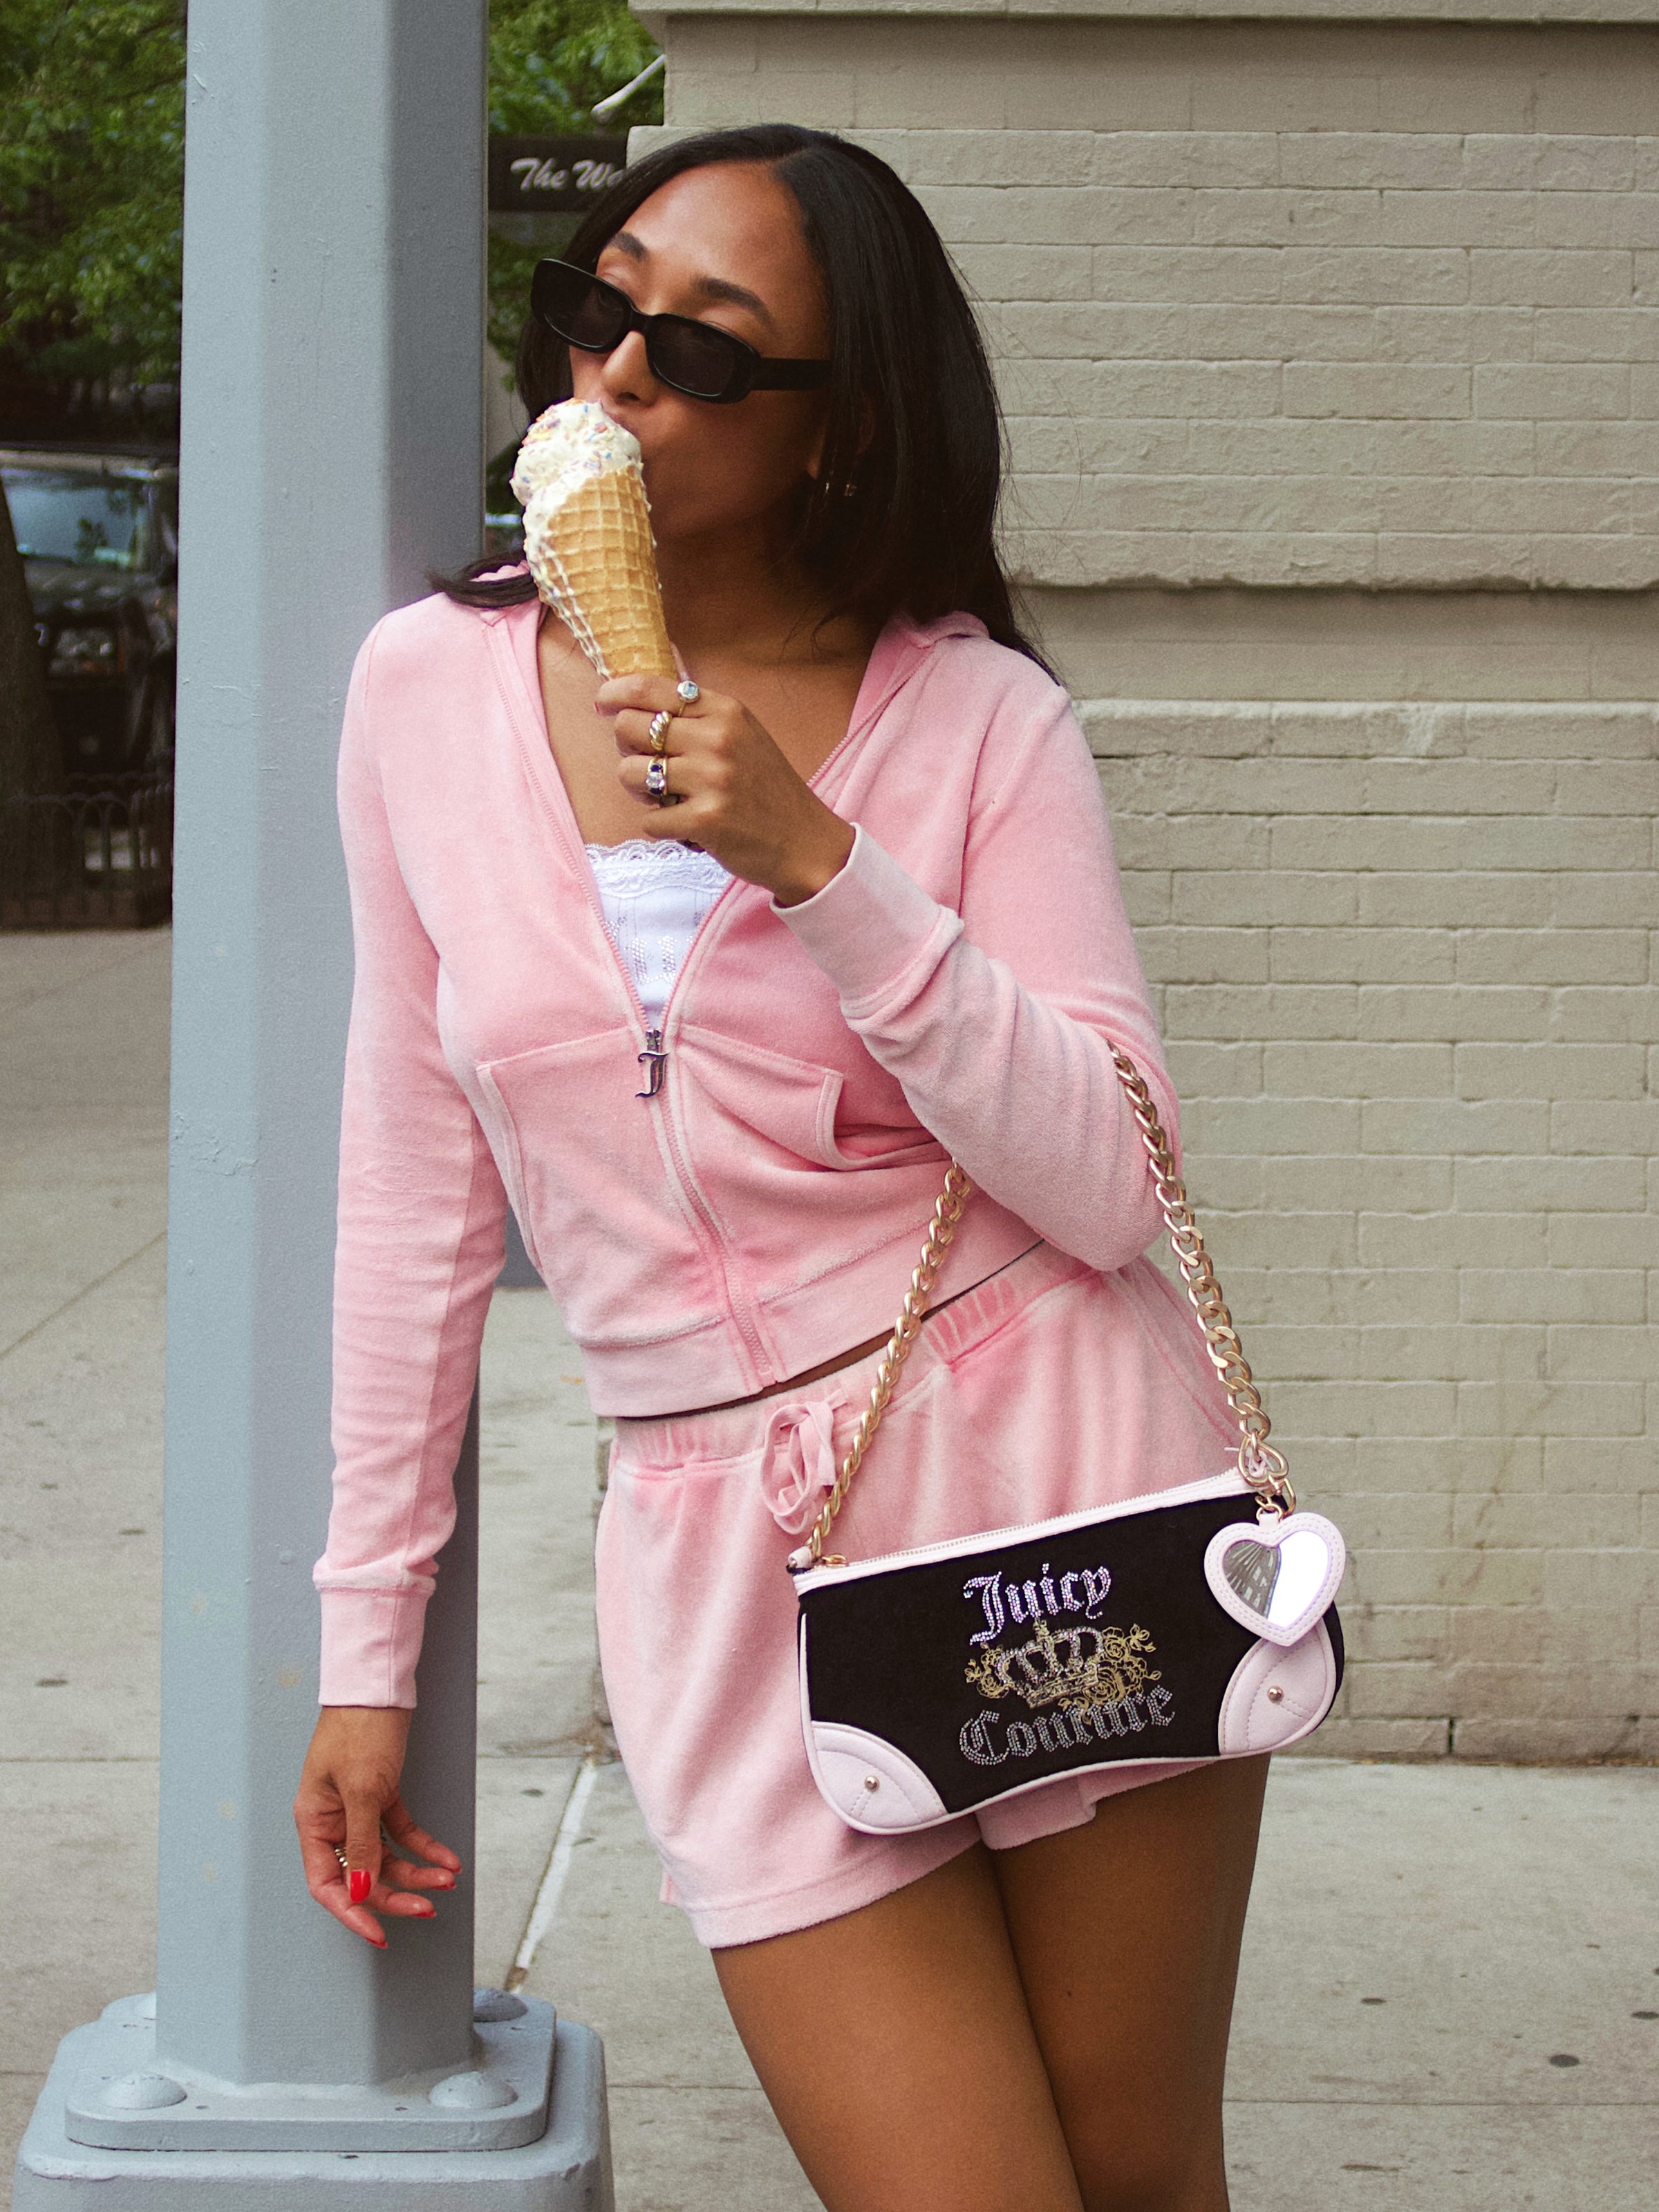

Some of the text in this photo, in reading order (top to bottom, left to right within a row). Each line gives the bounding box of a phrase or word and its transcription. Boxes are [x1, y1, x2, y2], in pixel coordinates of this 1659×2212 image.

[510, 157, 568, 191] The
[963, 1562, 1112, 1645] Juicy
[959, 1684, 1175, 1765] Couture
